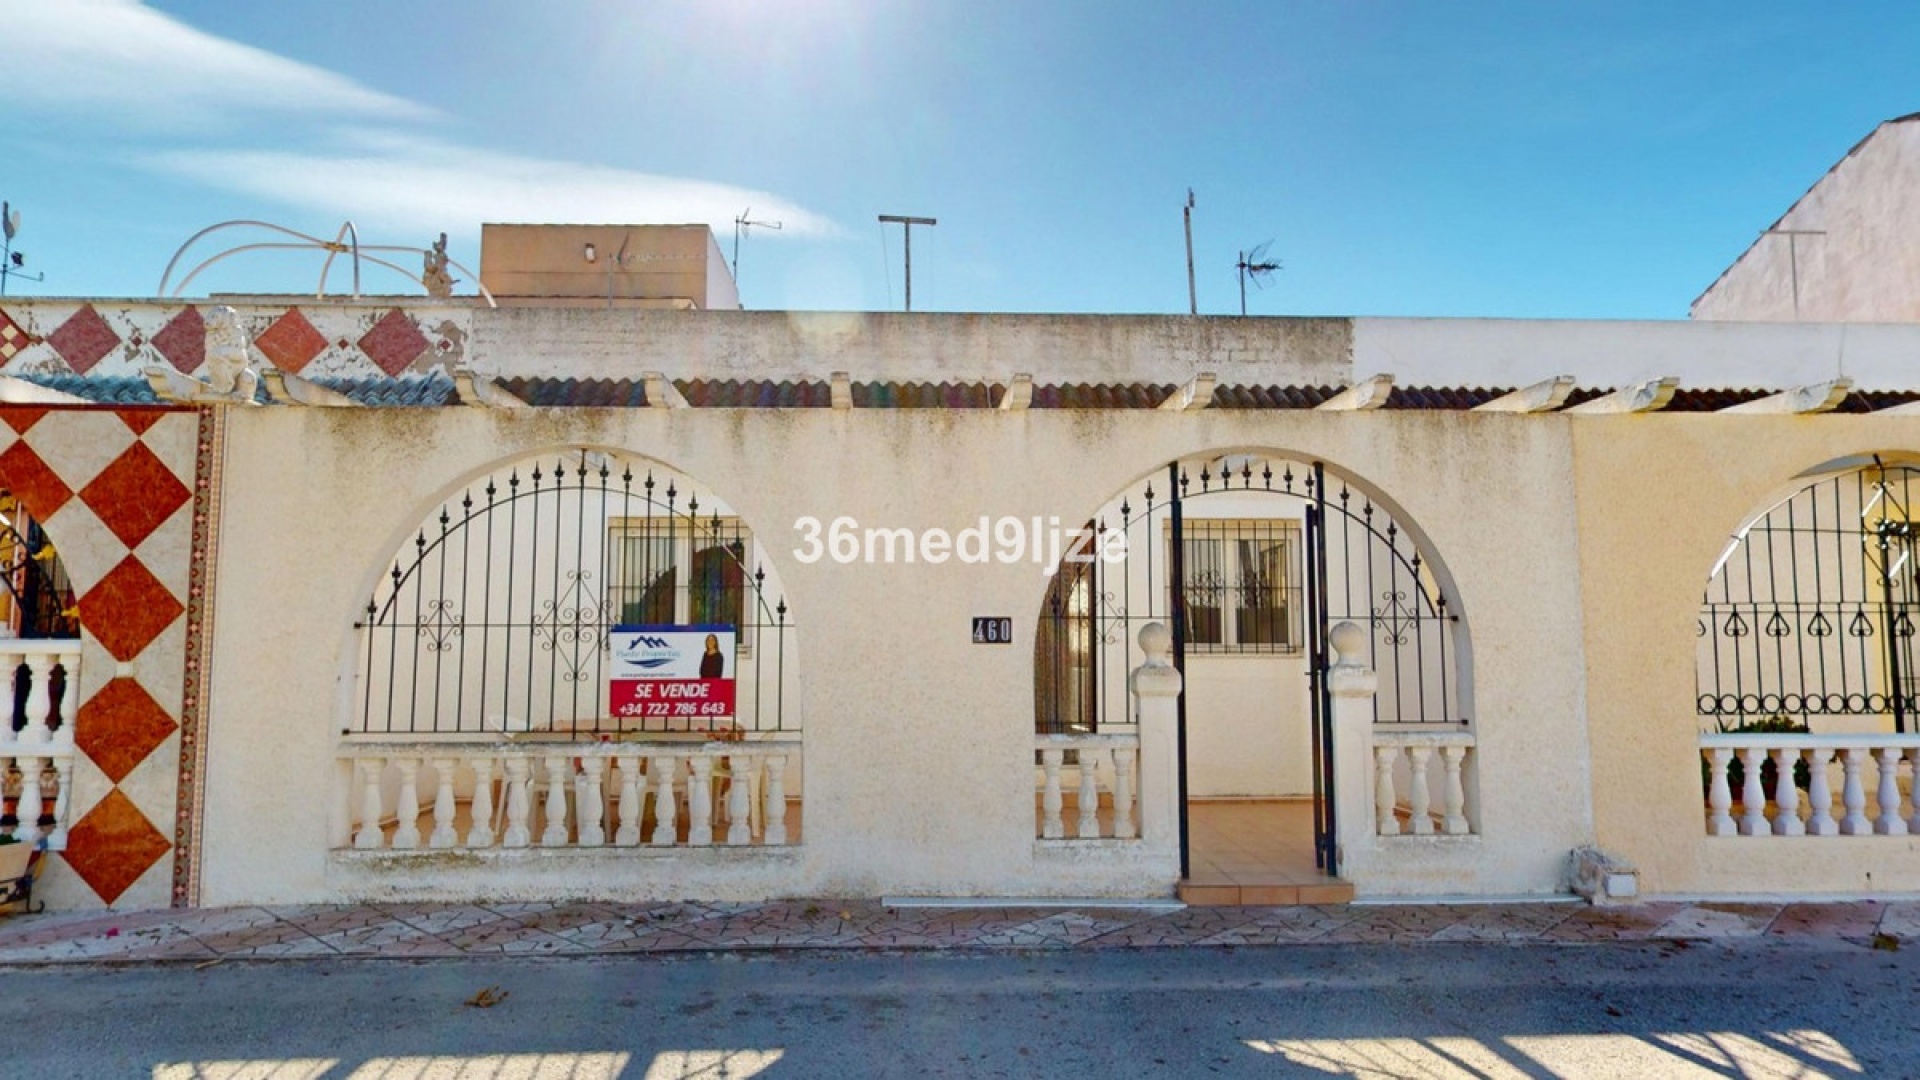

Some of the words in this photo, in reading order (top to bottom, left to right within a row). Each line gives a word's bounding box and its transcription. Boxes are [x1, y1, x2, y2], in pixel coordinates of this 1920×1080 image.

[973, 619, 1010, 641] 460
[634, 682, 654, 698] SE
[659, 682, 711, 698] VENDE
[619, 702, 642, 716] +34
[647, 701, 670, 715] 722
[674, 701, 697, 715] 786
[701, 701, 726, 715] 643
